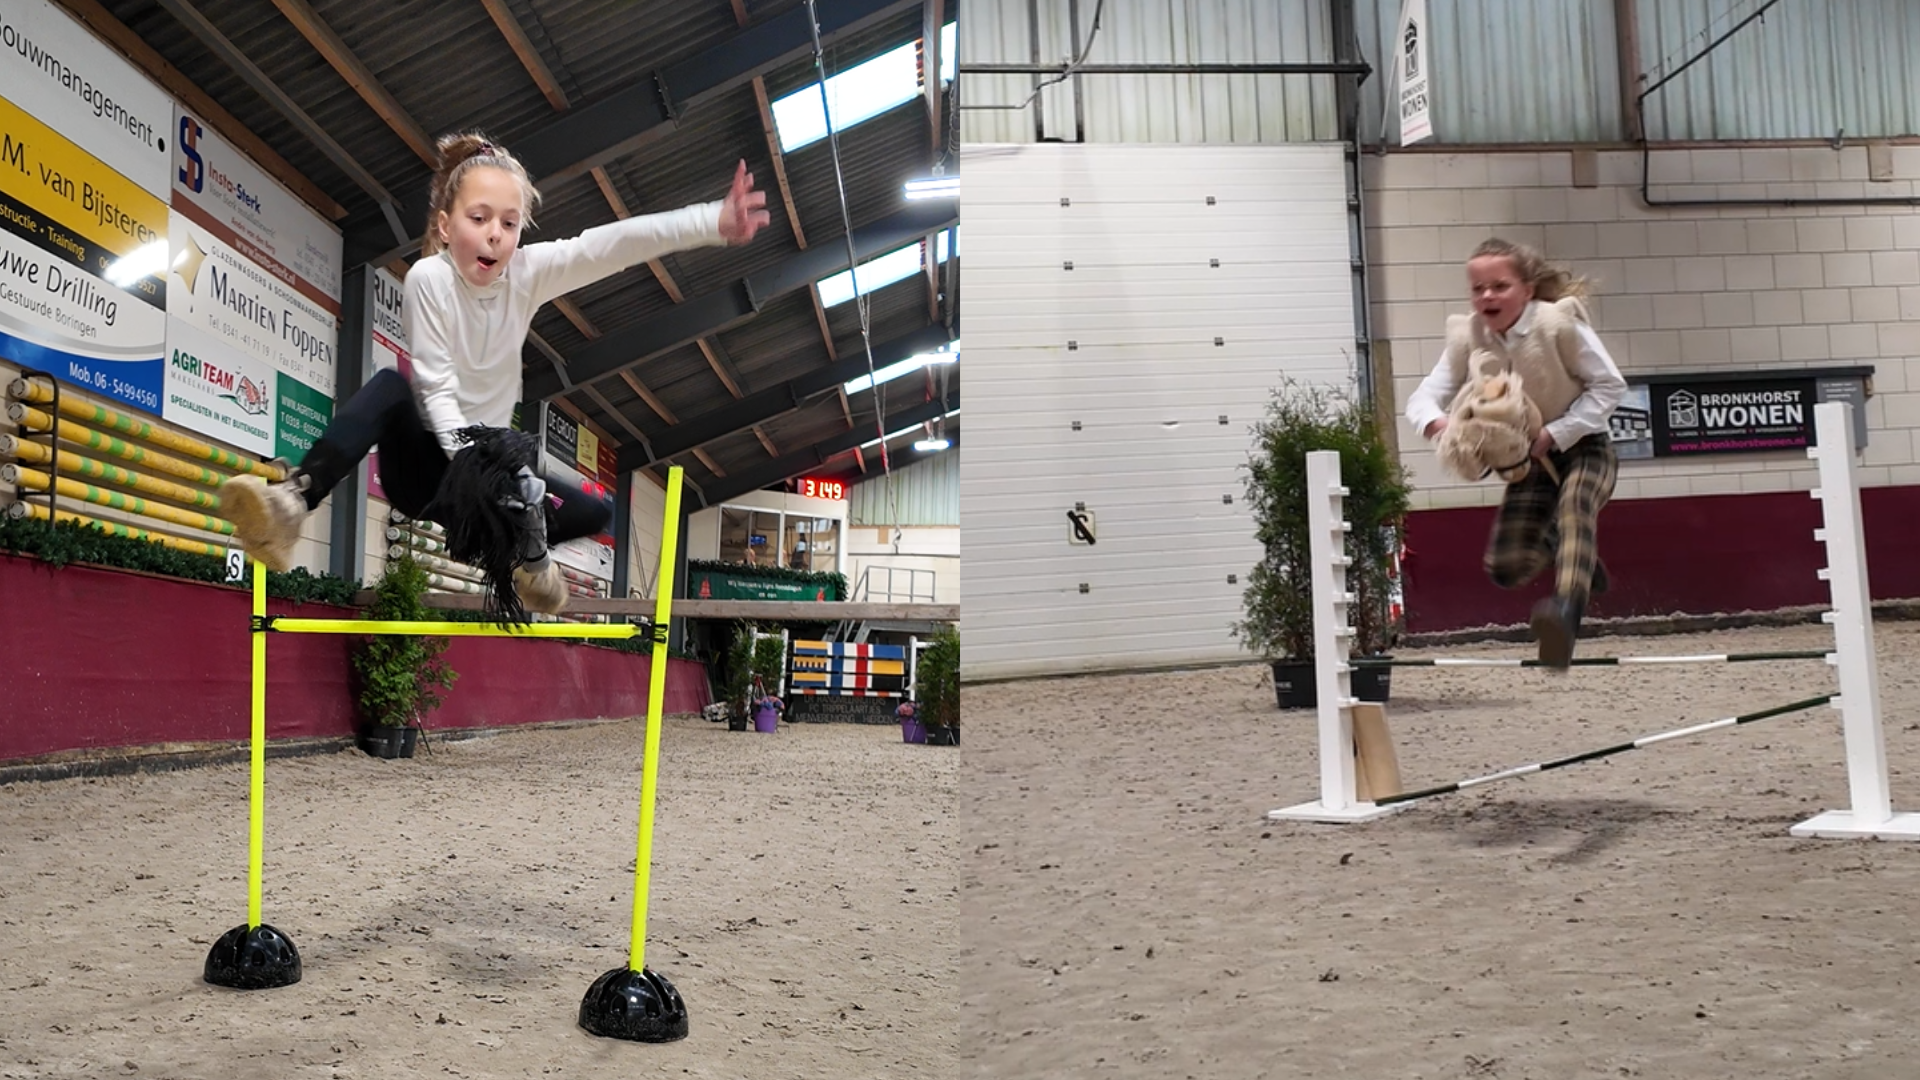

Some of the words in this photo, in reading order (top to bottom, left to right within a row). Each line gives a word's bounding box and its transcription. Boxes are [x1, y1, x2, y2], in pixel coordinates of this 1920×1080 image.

[0, 12, 153, 147] ouwmanagement
[2, 133, 30, 176] M.
[39, 162, 75, 202] van
[82, 181, 157, 244] Bijsteren
[208, 161, 262, 215] Insta-Sterk
[47, 226, 85, 262] Training
[211, 245, 267, 288] GLAZENWASSERS
[0, 282, 52, 319] Gestuurde
[55, 307, 97, 338] Boringen
[46, 264, 117, 326] Drilling
[209, 314, 221, 331] Tel.
[222, 319, 239, 340] 0341
[278, 352, 289, 367] Fax
[69, 361, 93, 384] Mob.
[94, 371, 107, 390] 06
[171, 370, 215, 395] MAKELAARS
[1701, 390, 1802, 406] BRONKHORST
[1701, 404, 1804, 428] WONEN
[170, 394, 212, 418] SPECIALISTEN
[213, 411, 220, 421] IN
[221, 414, 232, 425] HET
[232, 419, 269, 441] BUITENGEBIED
[281, 411, 285, 422] T
[556, 416, 577, 446] GROOT
[1670, 437, 1806, 451] www.bronkhorstwonen.nl
[230, 553, 240, 579] S
